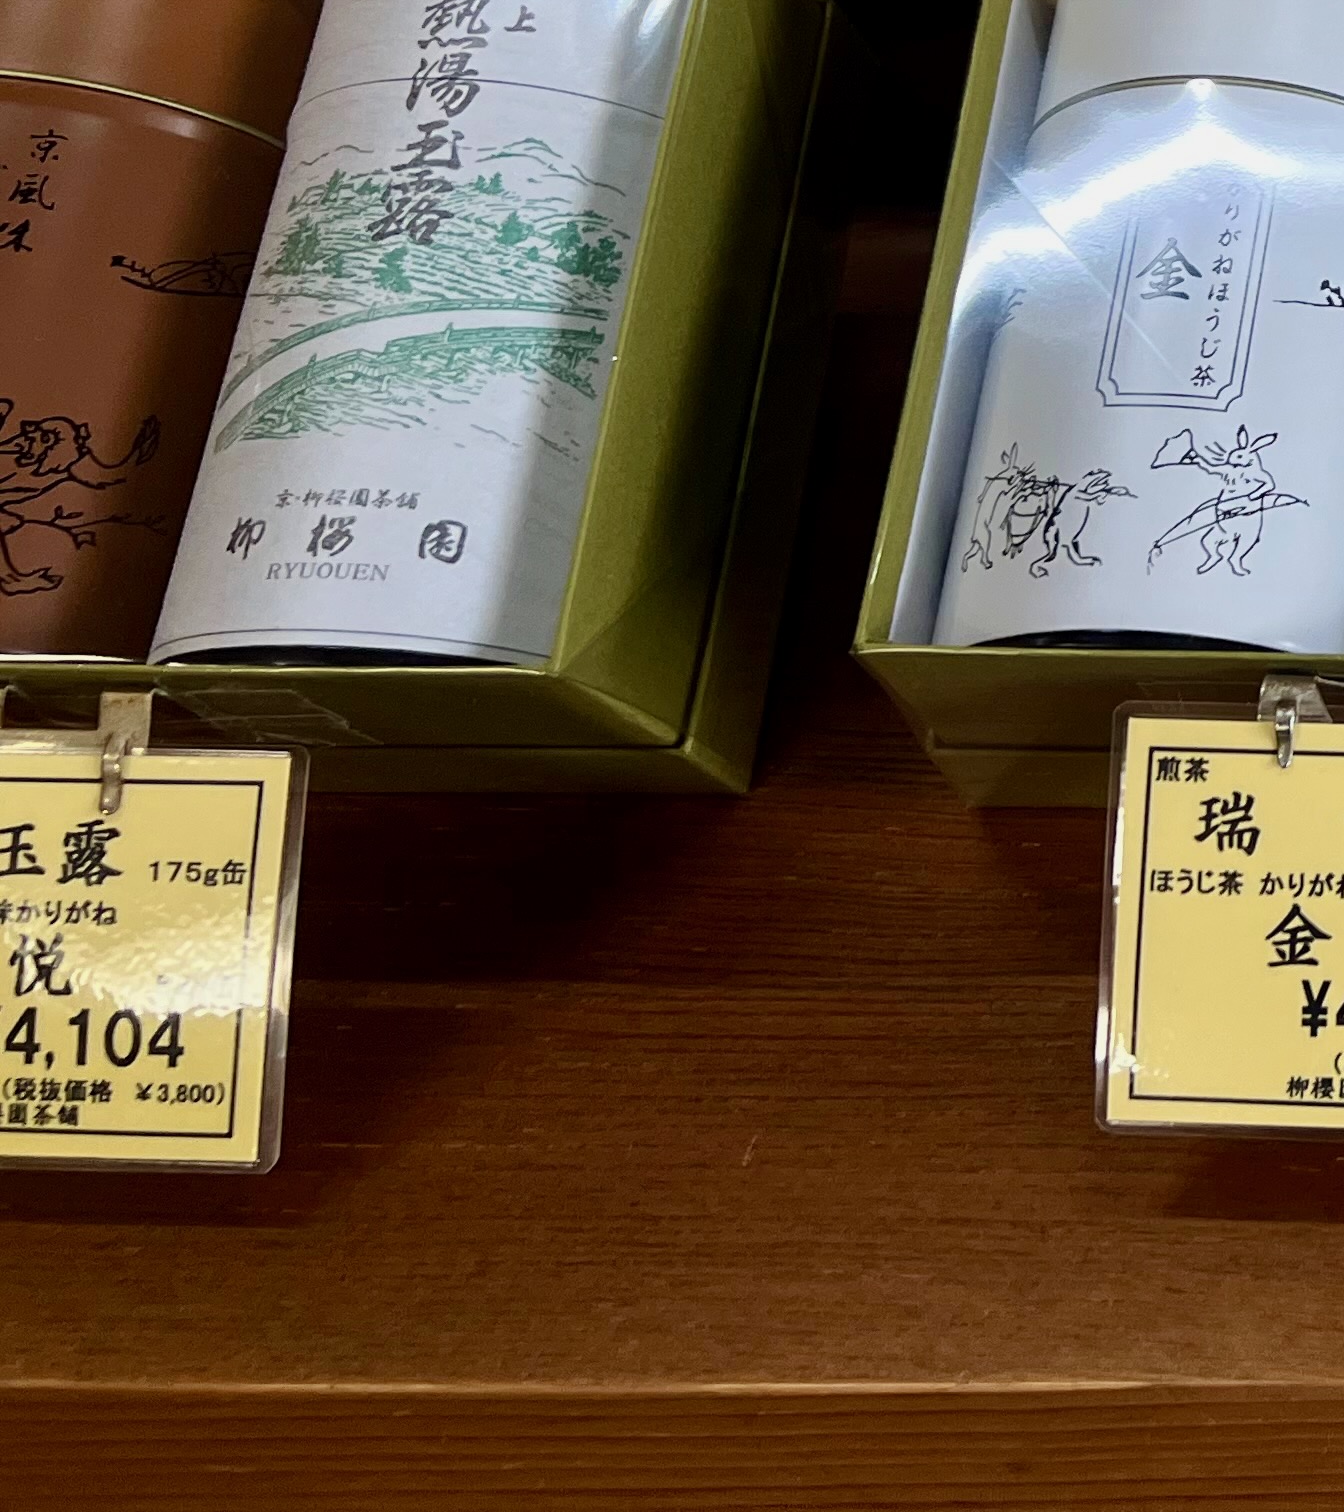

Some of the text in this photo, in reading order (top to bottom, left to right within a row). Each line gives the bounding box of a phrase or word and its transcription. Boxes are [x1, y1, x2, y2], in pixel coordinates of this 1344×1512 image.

[1135, 237, 1203, 301] 金
[265, 561, 391, 583] RYUOUEN
[1155, 757, 1210, 783] 煎茶
[147, 859, 248, 887] 175g缶
[1150, 869, 1244, 896] ほうじ茶
[1265, 903, 1333, 968] 金
[9, 932, 74, 997] 悦
[0, 1005, 186, 1072] 4,104
[2, 1076, 226, 1106] (税抜価格 ¥3,800)
[0, 1103, 80, 1128] 園茶舗
